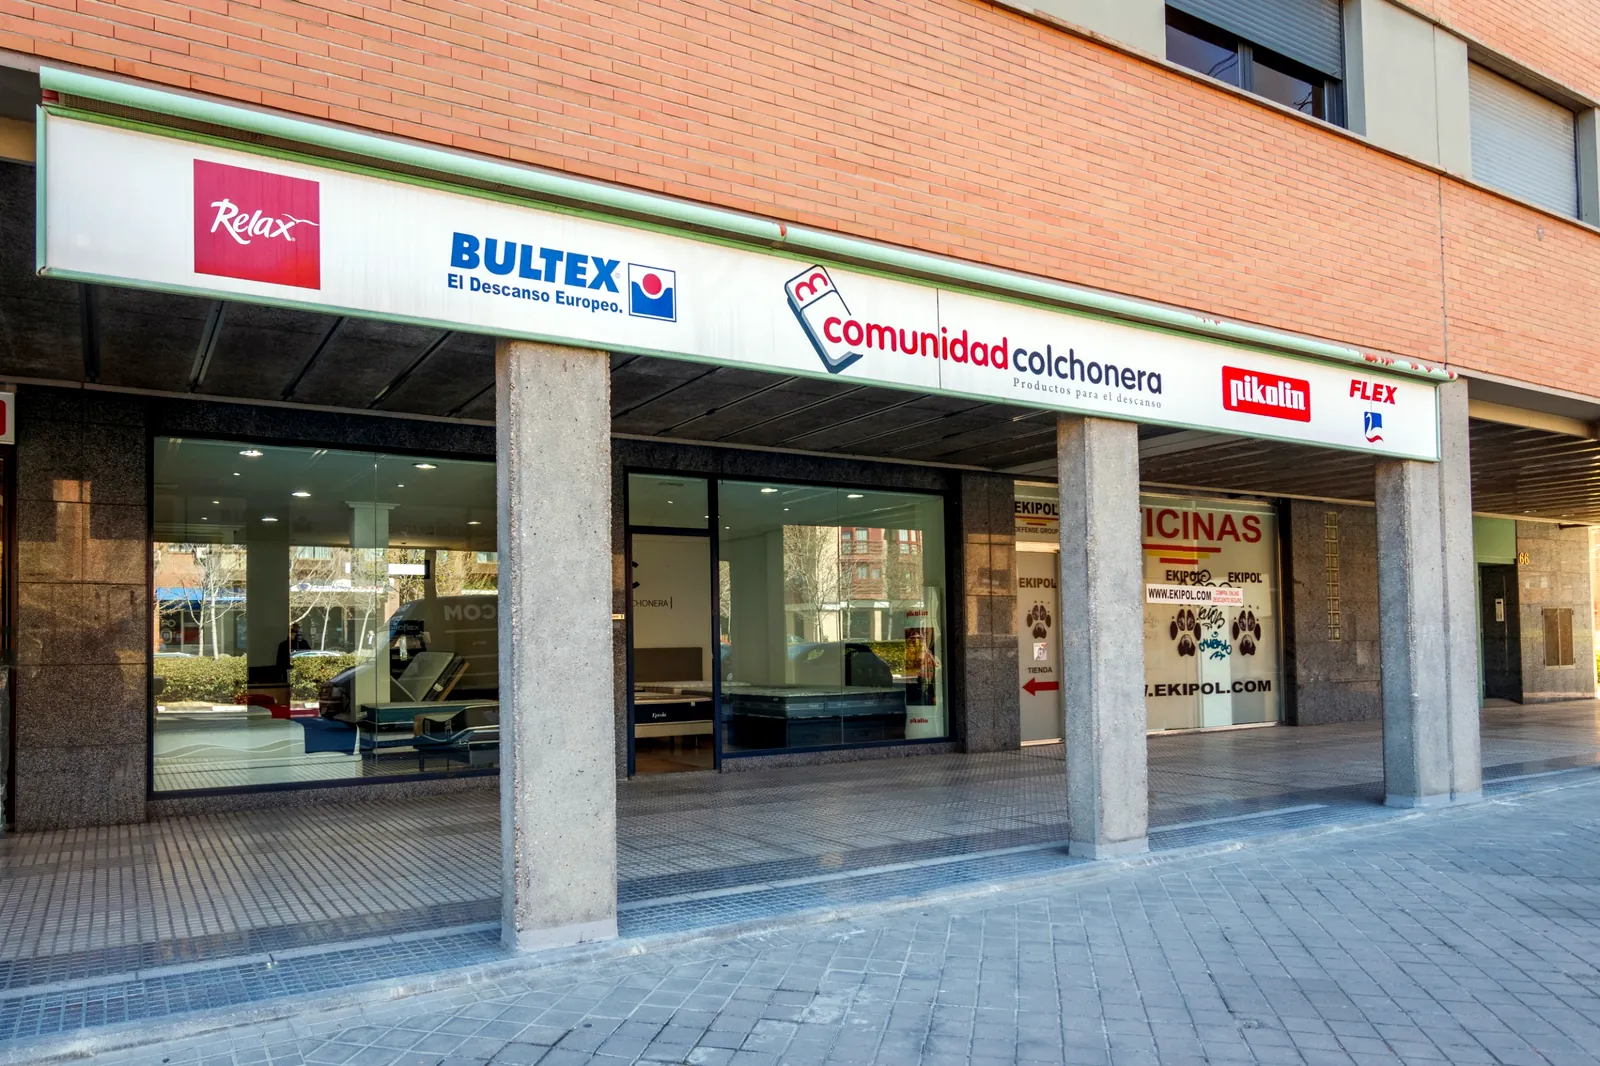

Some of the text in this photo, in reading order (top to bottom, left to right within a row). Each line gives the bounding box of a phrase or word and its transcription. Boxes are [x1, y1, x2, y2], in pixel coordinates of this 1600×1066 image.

[210, 198, 296, 244] Relax
[450, 231, 620, 293] BULTEX
[447, 273, 623, 313] El Descanso Europeo.
[823, 315, 1162, 394] comunidad colchonera
[1013, 377, 1162, 409] Productos para el descanso
[1230, 375, 1306, 410] pikolin
[1349, 379, 1398, 405] FLEX
[1015, 501, 1059, 516] EKIPOL
[1040, 527, 1059, 535] GROUP
[1140, 508, 1262, 543] ICINAS
[1519, 552, 1530, 565] 66
[1019, 578, 1057, 588] EKIPOL
[1228, 572, 1262, 583] EKIPOL
[1148, 588, 1212, 601] WWW.EKIPOL.COM
[1145, 680, 1271, 697] .EKIPOL.COM
